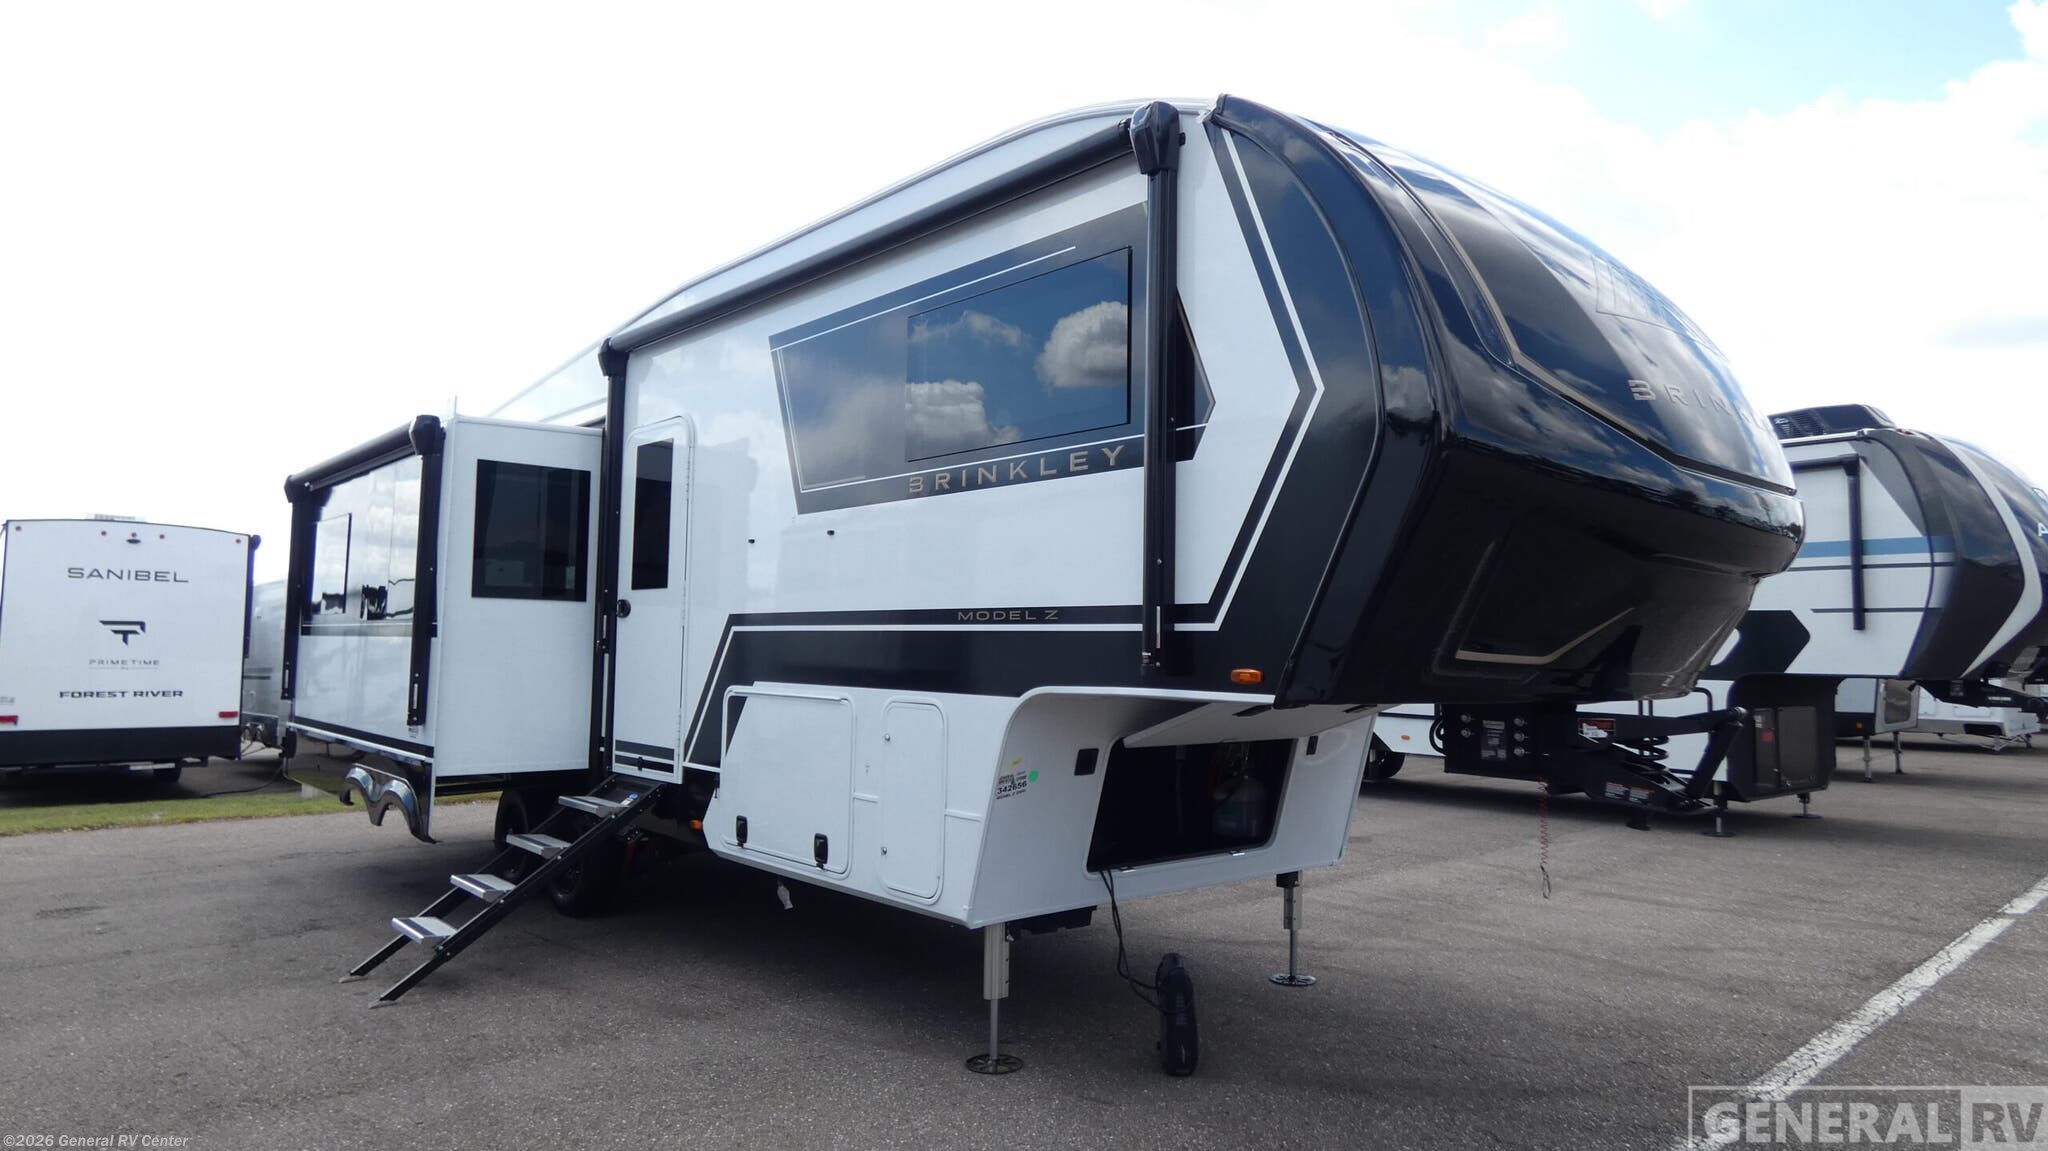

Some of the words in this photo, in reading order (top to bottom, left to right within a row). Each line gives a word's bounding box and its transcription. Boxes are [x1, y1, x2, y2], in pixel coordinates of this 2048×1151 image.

[908, 444, 1125, 494] BRINKLEY
[67, 567, 189, 583] SANIBEL
[957, 610, 1037, 621] MODEL
[1044, 609, 1059, 620] Z
[59, 690, 129, 699] FOREST
[133, 690, 184, 698] RIVER
